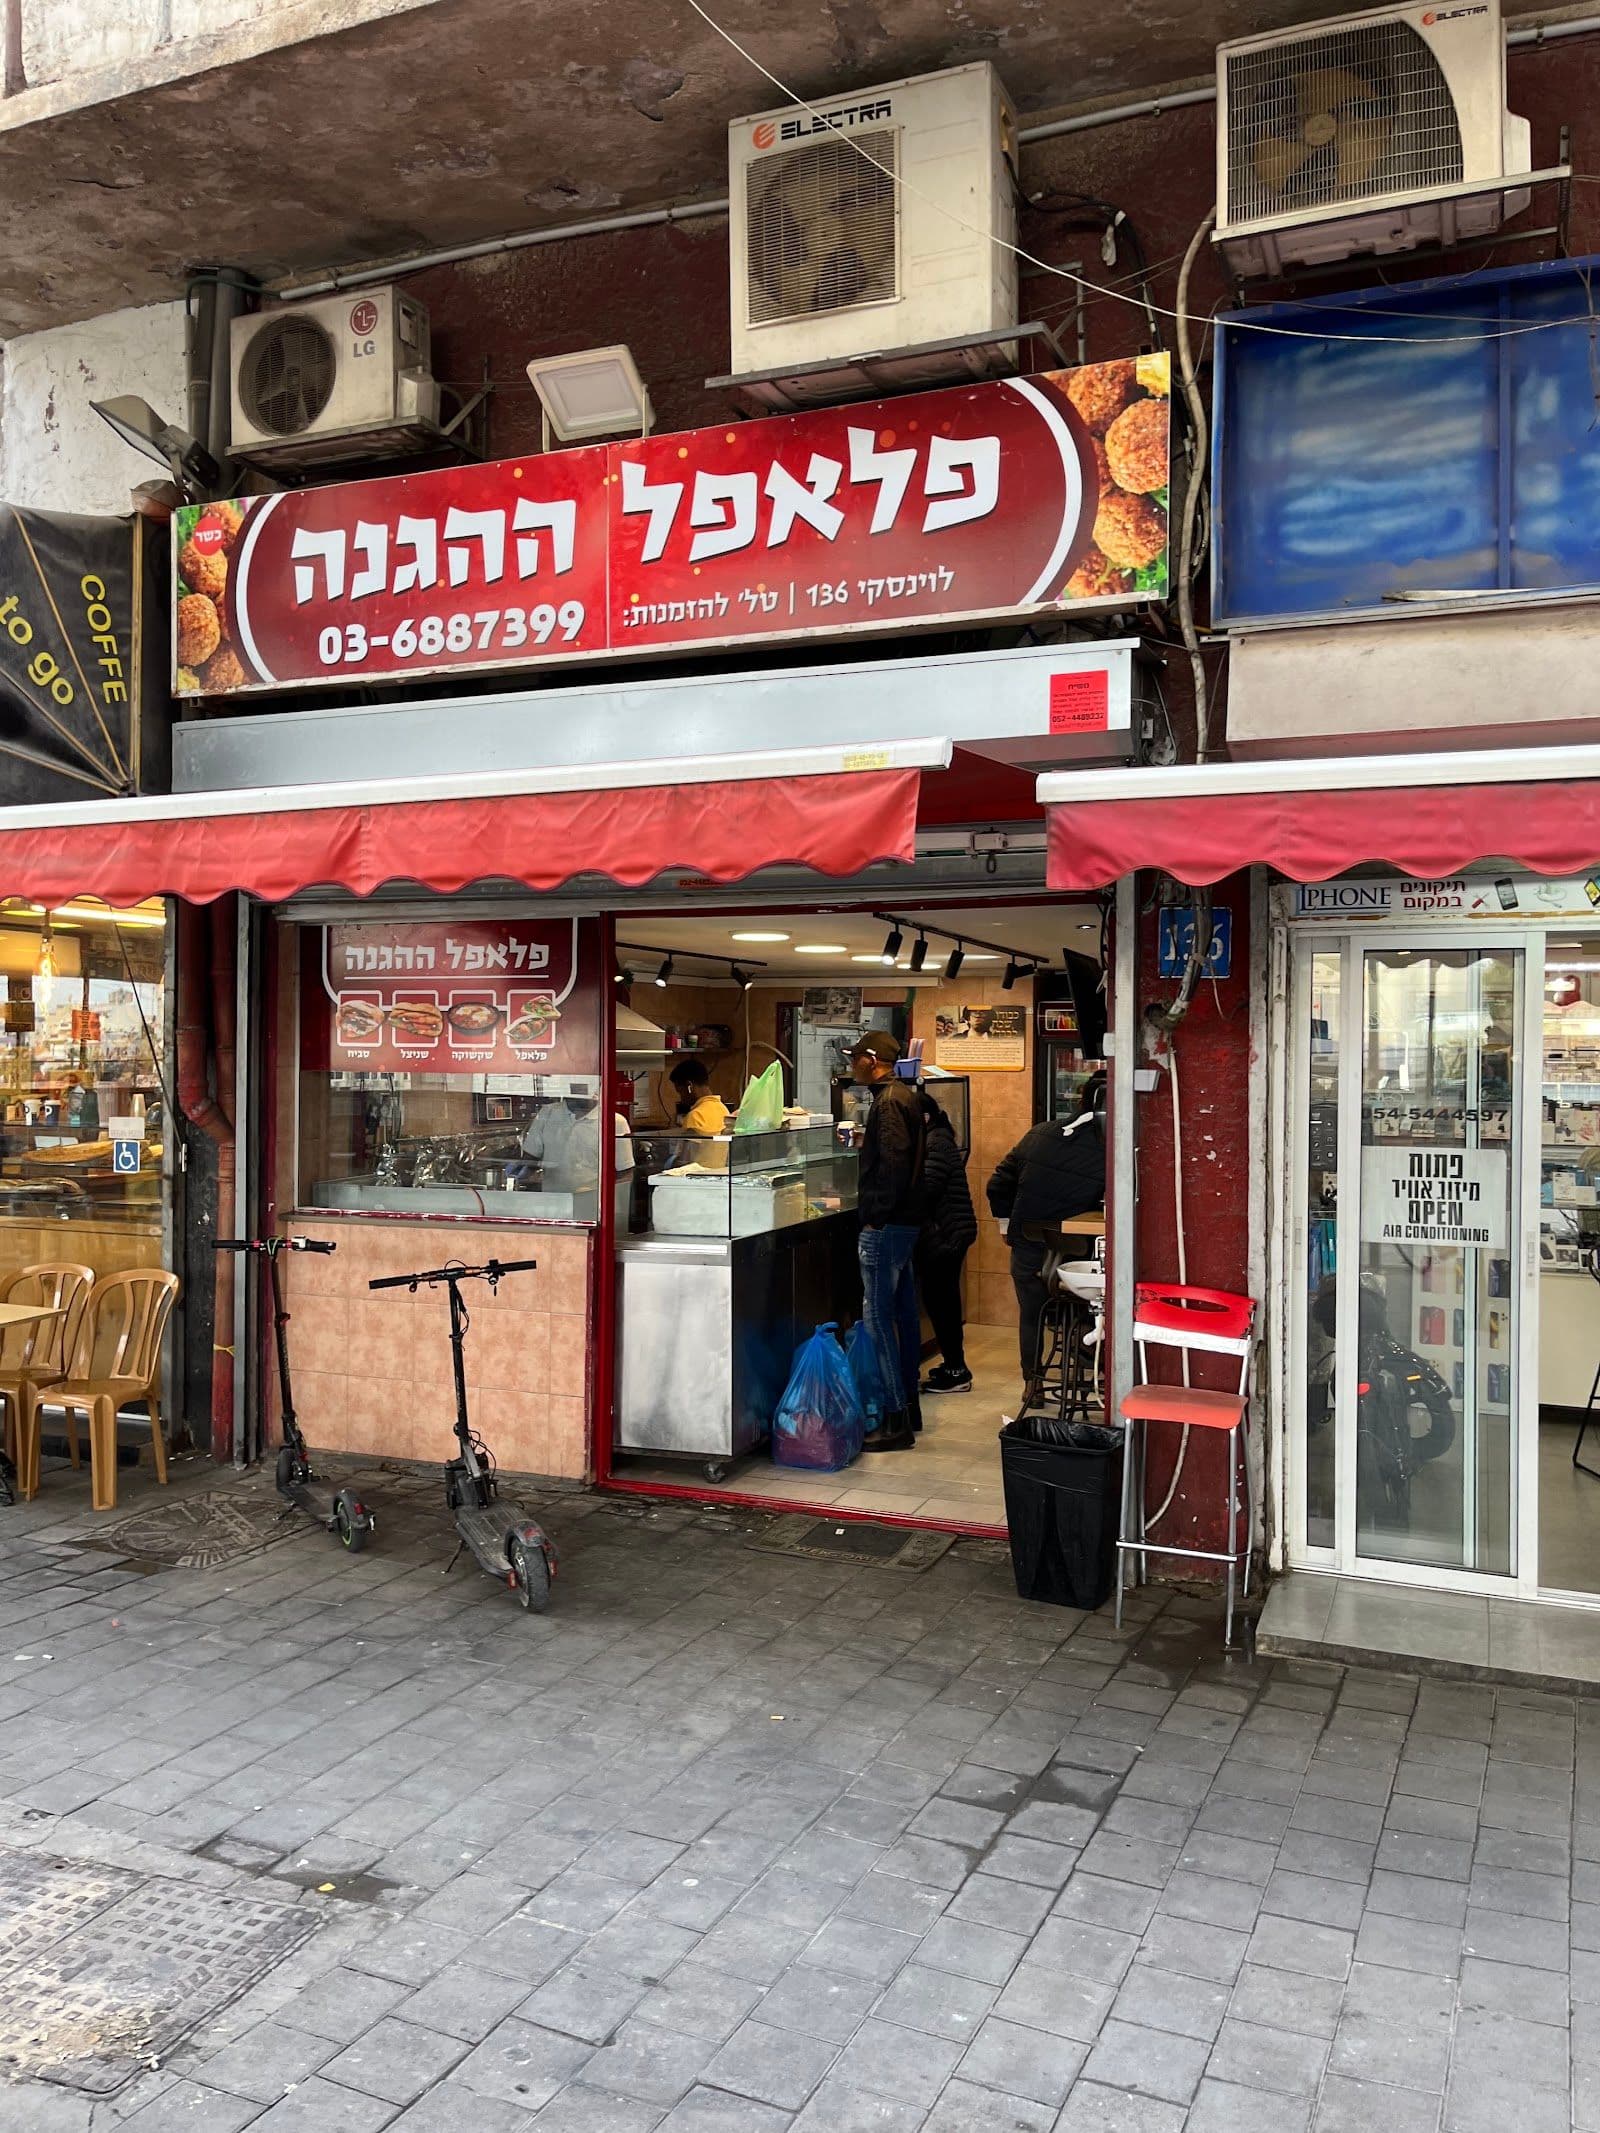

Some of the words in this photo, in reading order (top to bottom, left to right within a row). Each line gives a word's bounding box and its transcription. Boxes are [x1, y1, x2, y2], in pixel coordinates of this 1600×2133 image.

[1436, 5, 1489, 20] ELECTRA
[781, 99, 891, 140] ELECTRA
[353, 340, 376, 358] LG
[621, 426, 1001, 563] פלאפל
[195, 529, 222, 543] כשר
[290, 497, 578, 605] ההגנה
[806, 581, 849, 607] 136
[857, 565, 955, 606] לוינסקי
[623, 592, 729, 627] להזמנות:
[81, 574, 128, 704] COFFE
[318, 600, 585, 665] 03-6887399
[0, 595, 33, 645] to
[28, 652, 74, 705] go
[1400, 880, 1466, 896] תיקונים
[1403, 895, 1463, 911] במקום
[345, 944, 436, 972] ההגנה
[446, 936, 550, 971] פלאפל
[347, 1050, 370, 1059] סביח
[400, 1049, 429, 1060] שניצל
[452, 1050, 494, 1061] שקשוקה
[515, 1050, 548, 1061] פלאפל
[1409, 1153, 1464, 1178] פתוח
[1392, 1179, 1433, 1199] אוויר
[1437, 1181, 1480, 1201] מיזוג
[1408, 1200, 1463, 1226] OPEN
[1383, 1224, 1402, 1238] AIR
[1405, 1226, 1489, 1242] CONDITIONING
